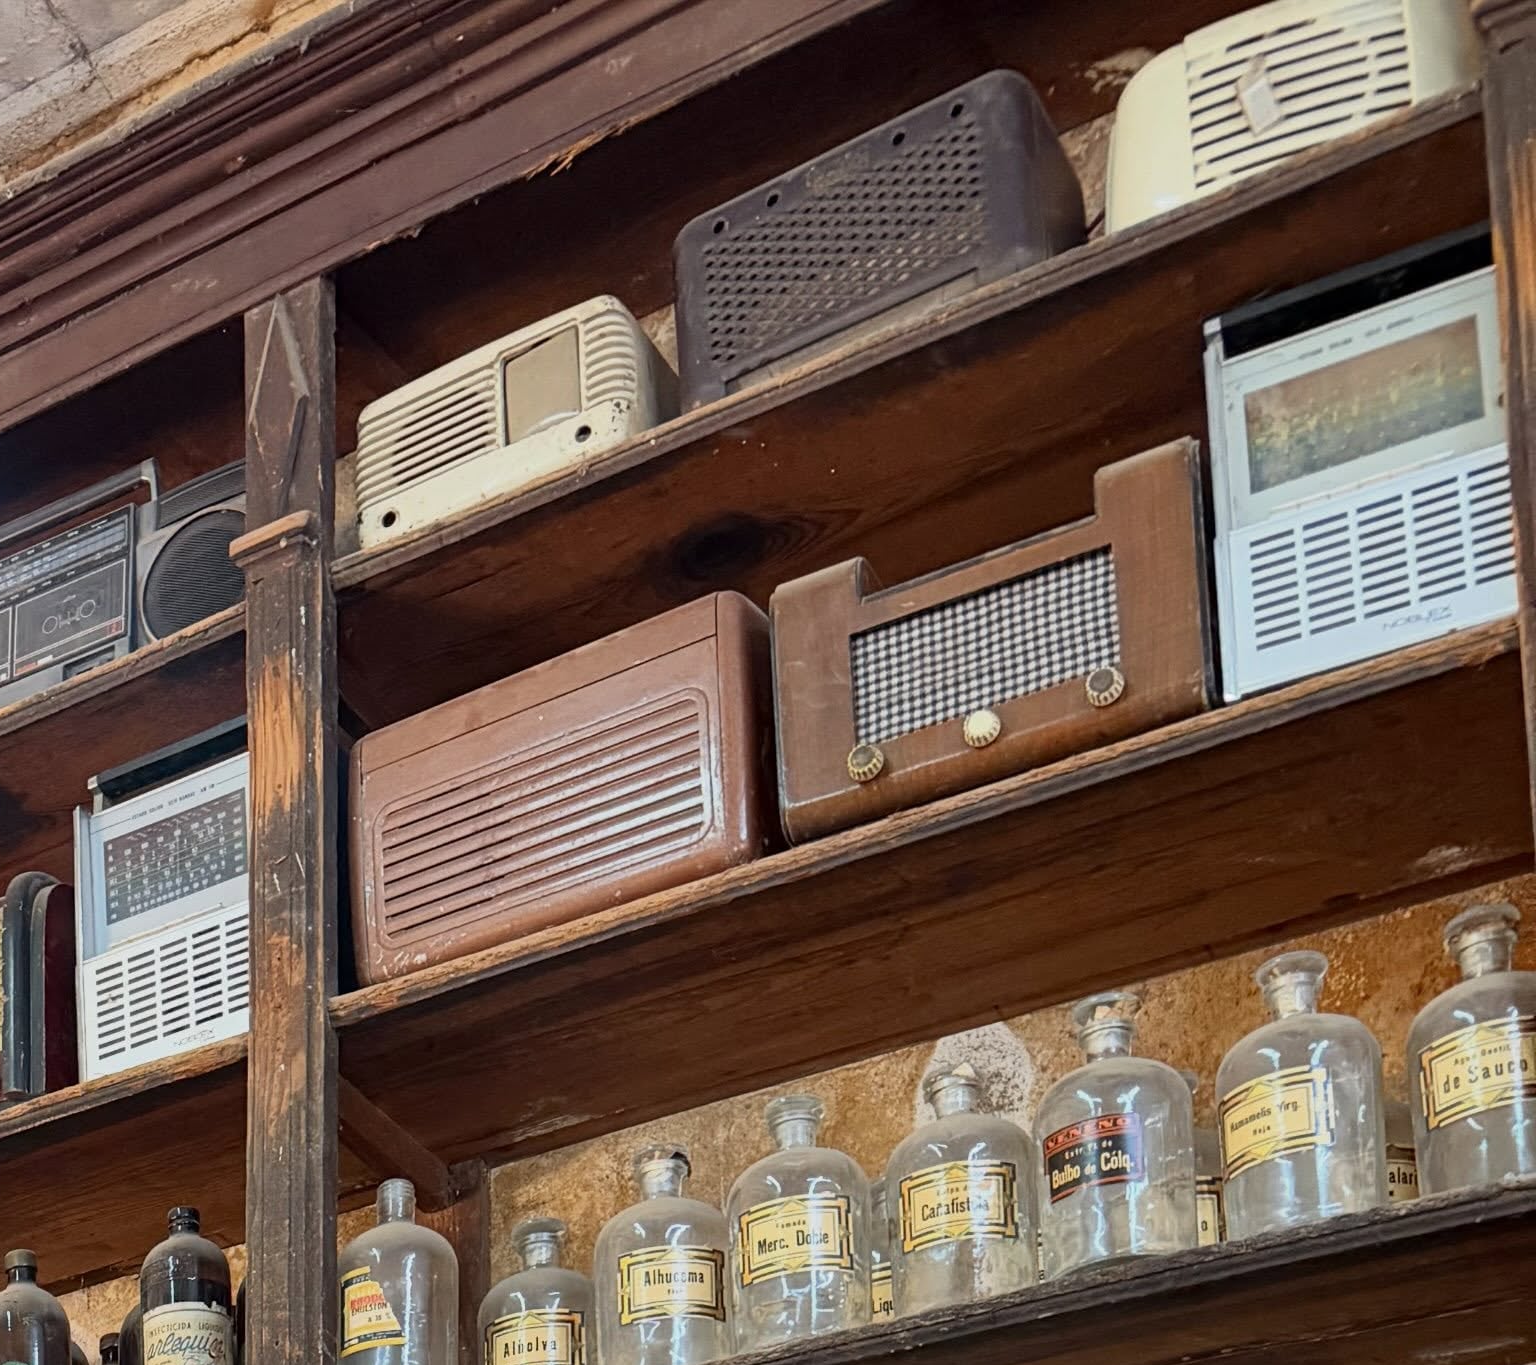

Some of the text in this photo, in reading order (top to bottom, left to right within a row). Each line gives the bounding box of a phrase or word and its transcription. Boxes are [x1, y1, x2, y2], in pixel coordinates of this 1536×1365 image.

[1443, 1073, 1461, 1094] de
[1047, 1116, 1132, 1149] VENENO
[1051, 1165, 1081, 1190] Bulbo
[1084, 1162, 1097, 1175] de
[757, 1238, 790, 1256] Merc.
